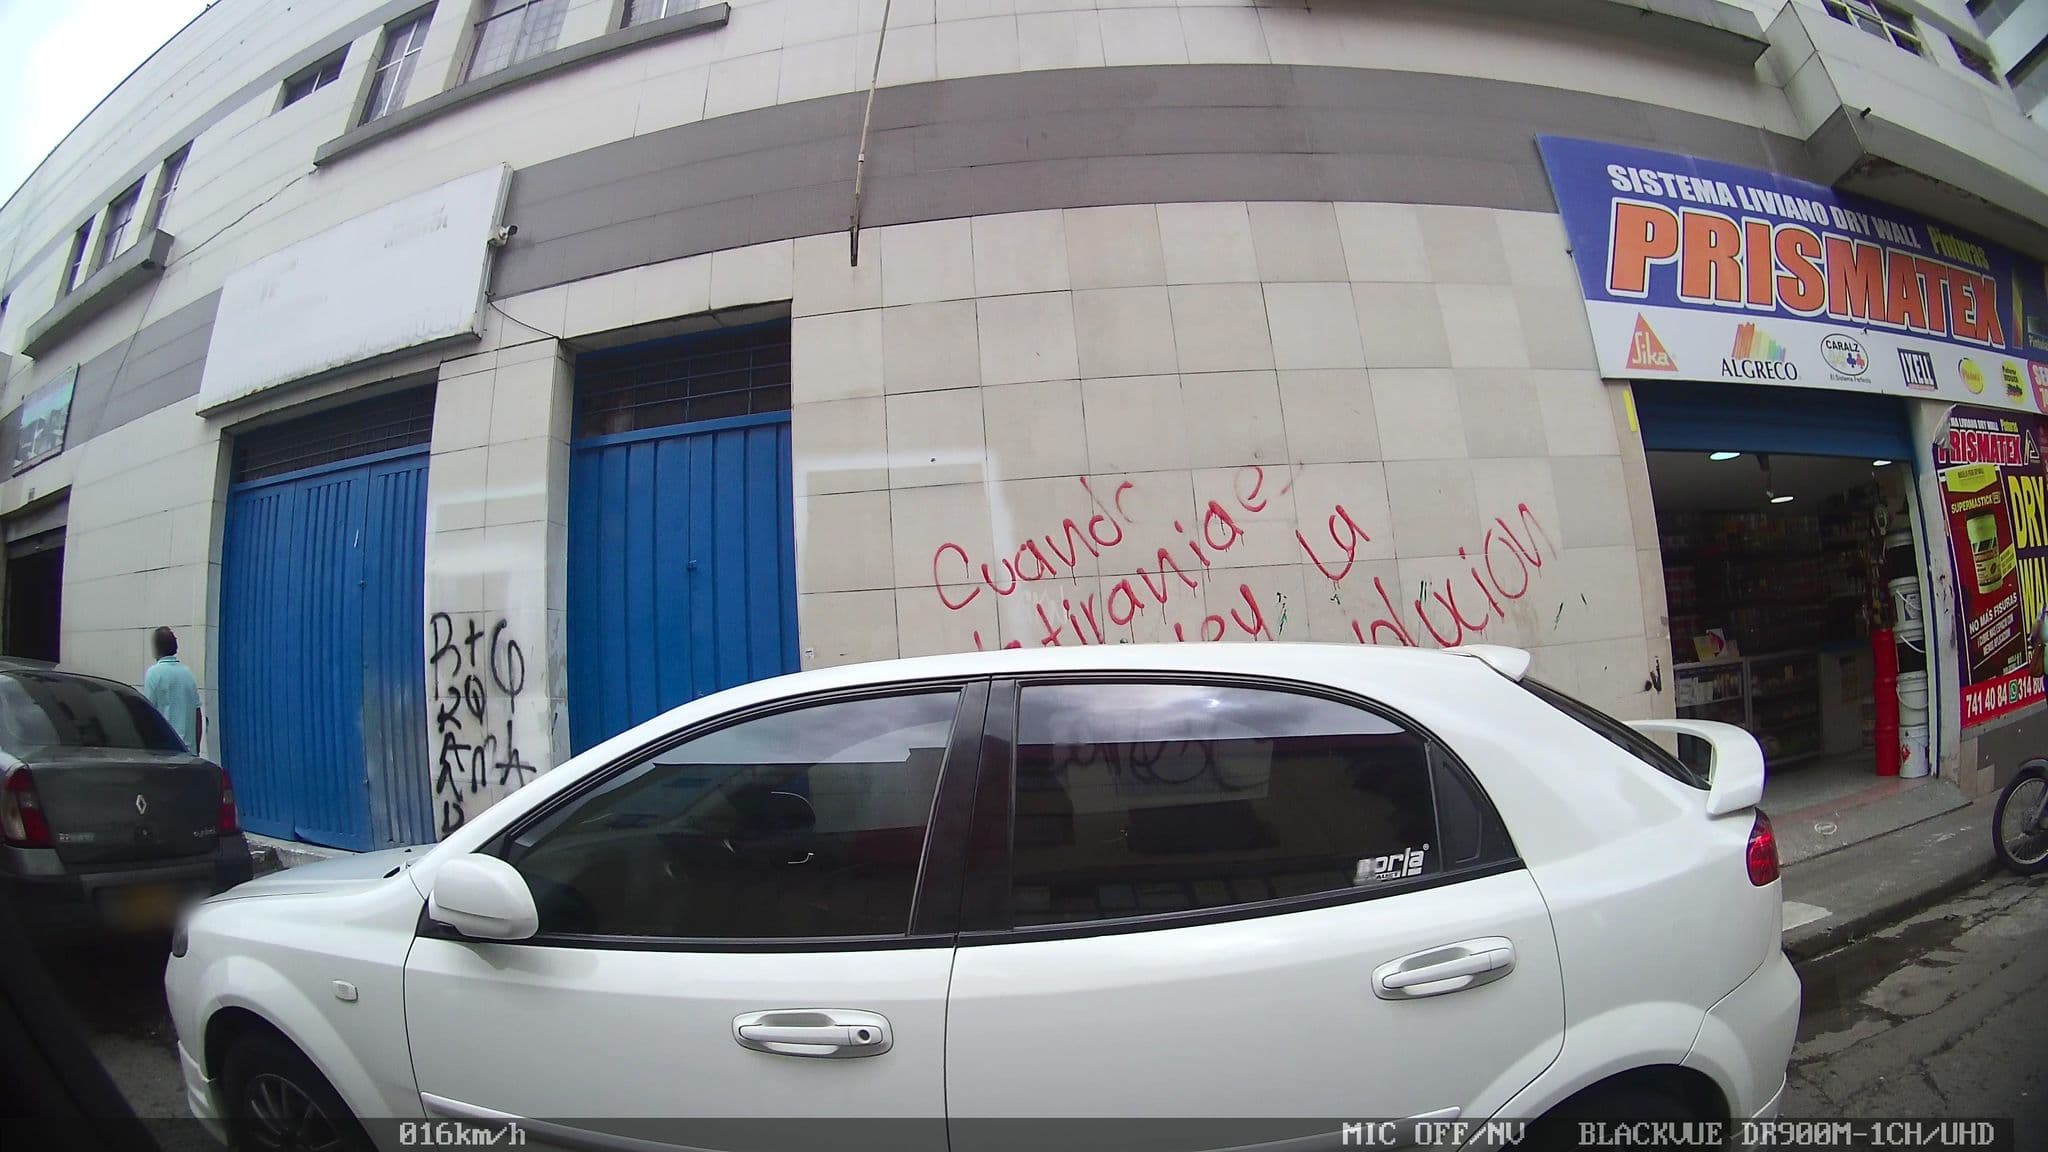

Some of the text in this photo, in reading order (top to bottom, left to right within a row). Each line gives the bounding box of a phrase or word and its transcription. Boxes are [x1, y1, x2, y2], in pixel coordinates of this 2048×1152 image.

[1607, 164, 1738, 208] SISTEMA
[1735, 185, 1830, 226] LIVIANO
[1829, 205, 1871, 236] DRY
[1870, 215, 1921, 249] WALL
[1606, 196, 2006, 349] PRISMATEX
[1632, 330, 1670, 367] Sika
[1825, 339, 1860, 353] CARALZ
[1721, 358, 1798, 381] ALGRECO
[1900, 352, 1935, 385] IXELL
[2008, 475, 2048, 548] DRY
[1969, 620, 1980, 635] NO
[1966, 690, 1983, 718] 741
[1985, 687, 1996, 711] 40
[1997, 683, 2008, 708] 84
[2018, 675, 2032, 701] 314
